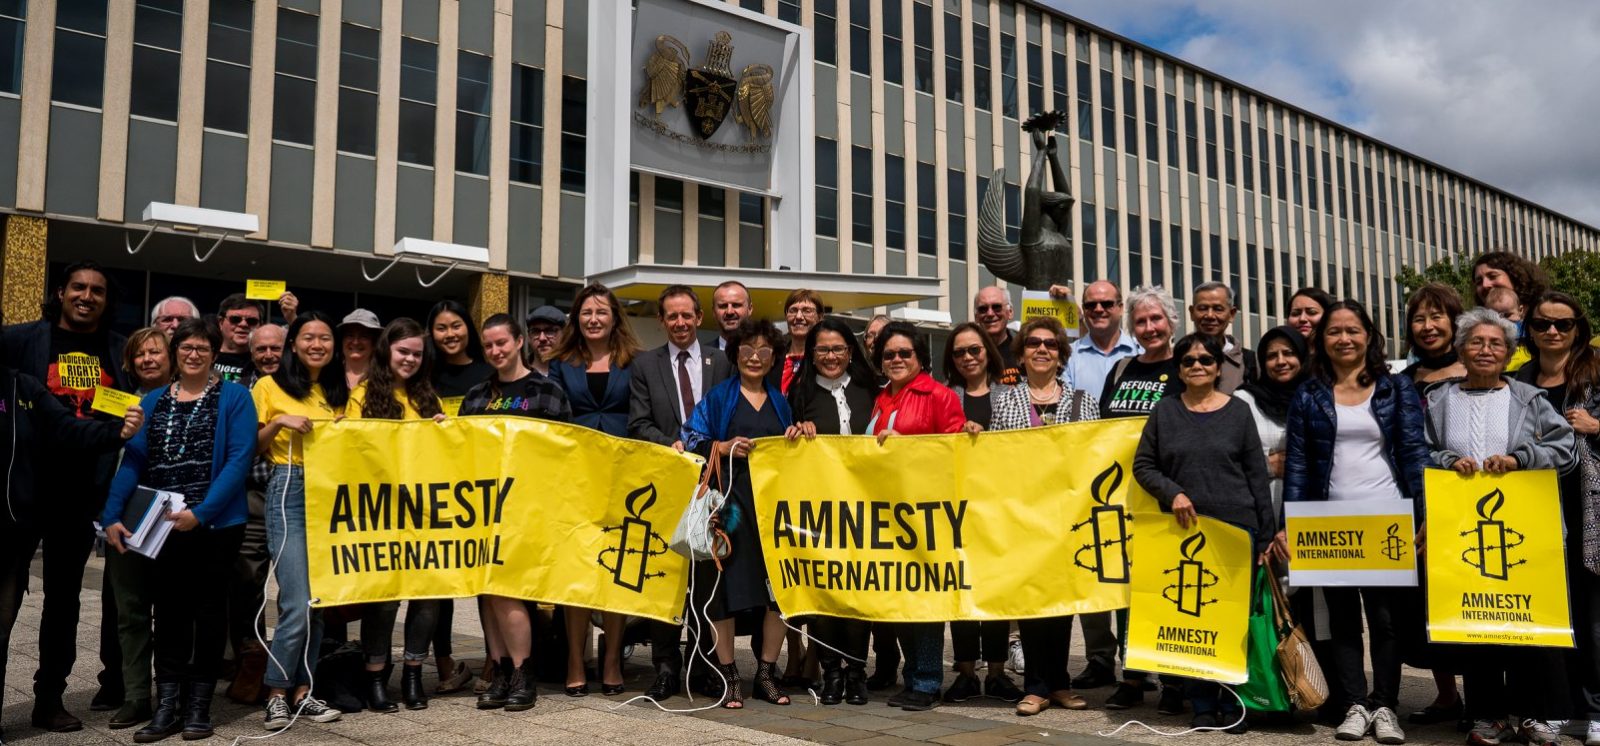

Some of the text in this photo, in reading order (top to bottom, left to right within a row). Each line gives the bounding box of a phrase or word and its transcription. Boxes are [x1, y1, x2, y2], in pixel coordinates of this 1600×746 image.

[1026, 306, 1060, 316] AMNESTY
[59, 354, 101, 365] INDIGENOUS
[68, 365, 100, 376] RIGHTS
[61, 376, 101, 387] DEFENDER
[1119, 381, 1167, 392] REFUGEE
[1114, 389, 1162, 401] LIVES
[329, 477, 514, 534] AMNESTY
[773, 500, 968, 551] AMNESTY
[1297, 530, 1364, 546] AMNESTY
[1297, 549, 1365, 559] INTERNATIONAL
[779, 558, 972, 592] INTERNATIONAL
[1461, 592, 1532, 609] AMNESTY
[1462, 610, 1534, 622] INTERNATIONAL
[1157, 626, 1218, 645] AMNESTY
[1466, 633, 1534, 641] www.amnesty.org.au
[1156, 642, 1217, 657] INTERNATIONAL
